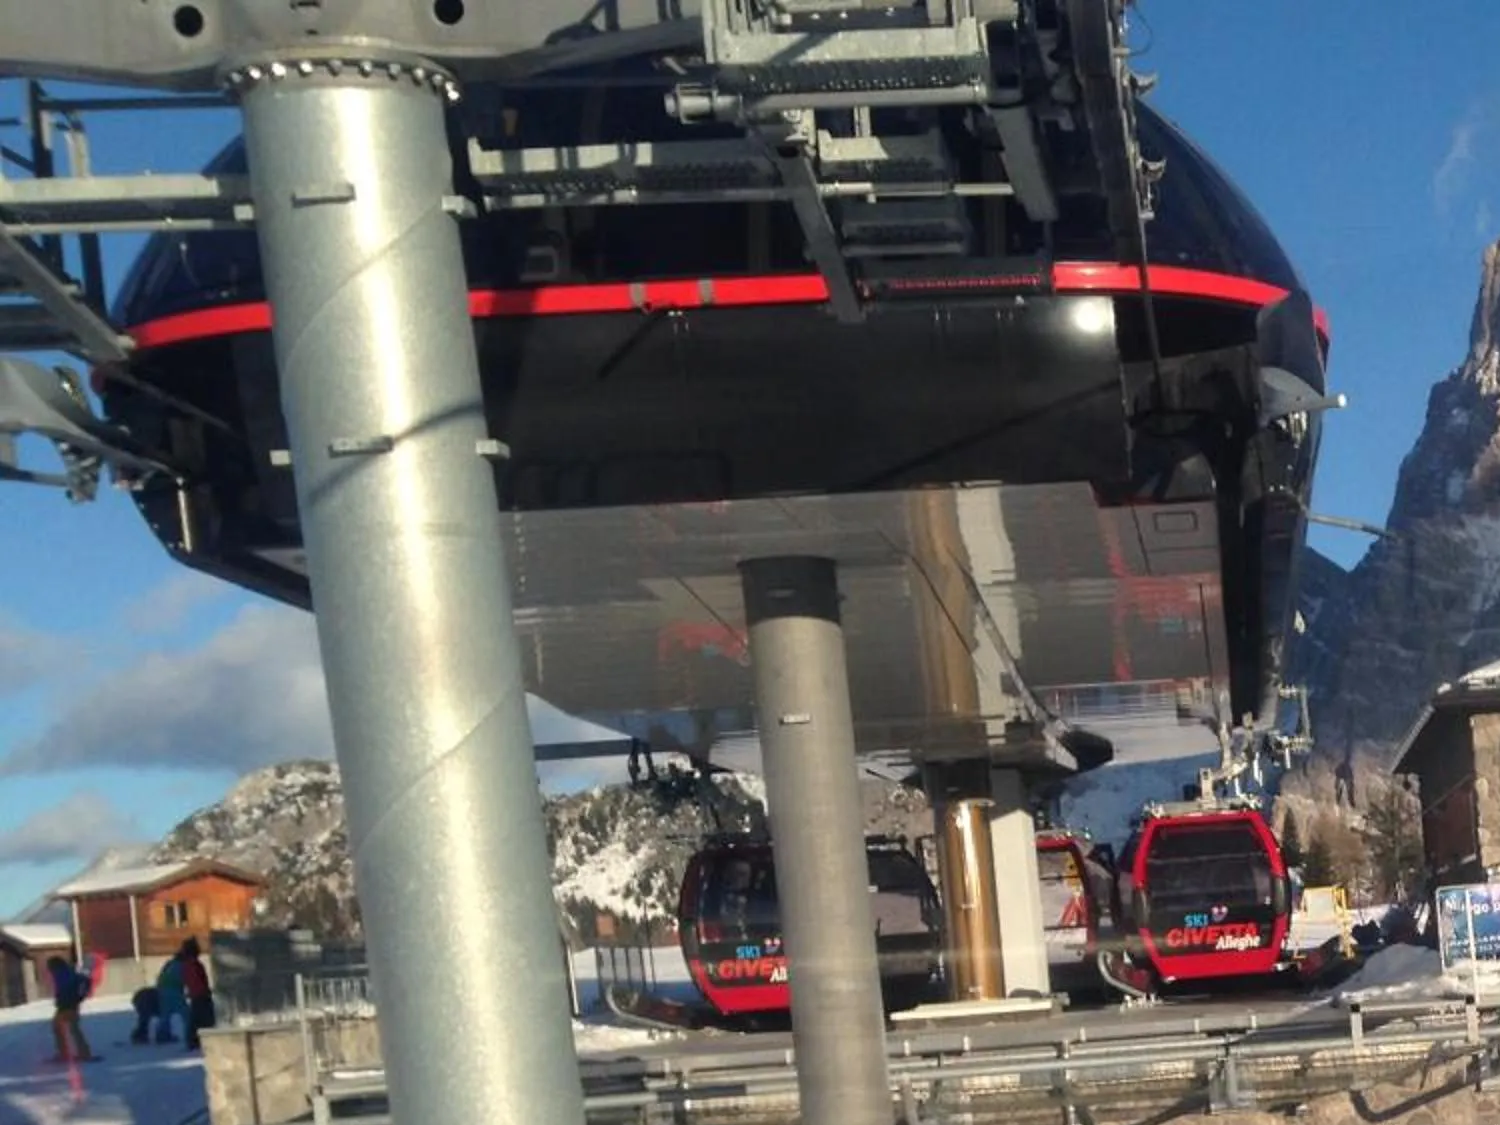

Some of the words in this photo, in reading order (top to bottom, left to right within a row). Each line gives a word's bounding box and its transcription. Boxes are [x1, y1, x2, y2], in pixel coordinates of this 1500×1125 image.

[1184, 914, 1208, 928] SKI
[1216, 934, 1260, 951] Alleghe
[736, 945, 760, 959] SKI
